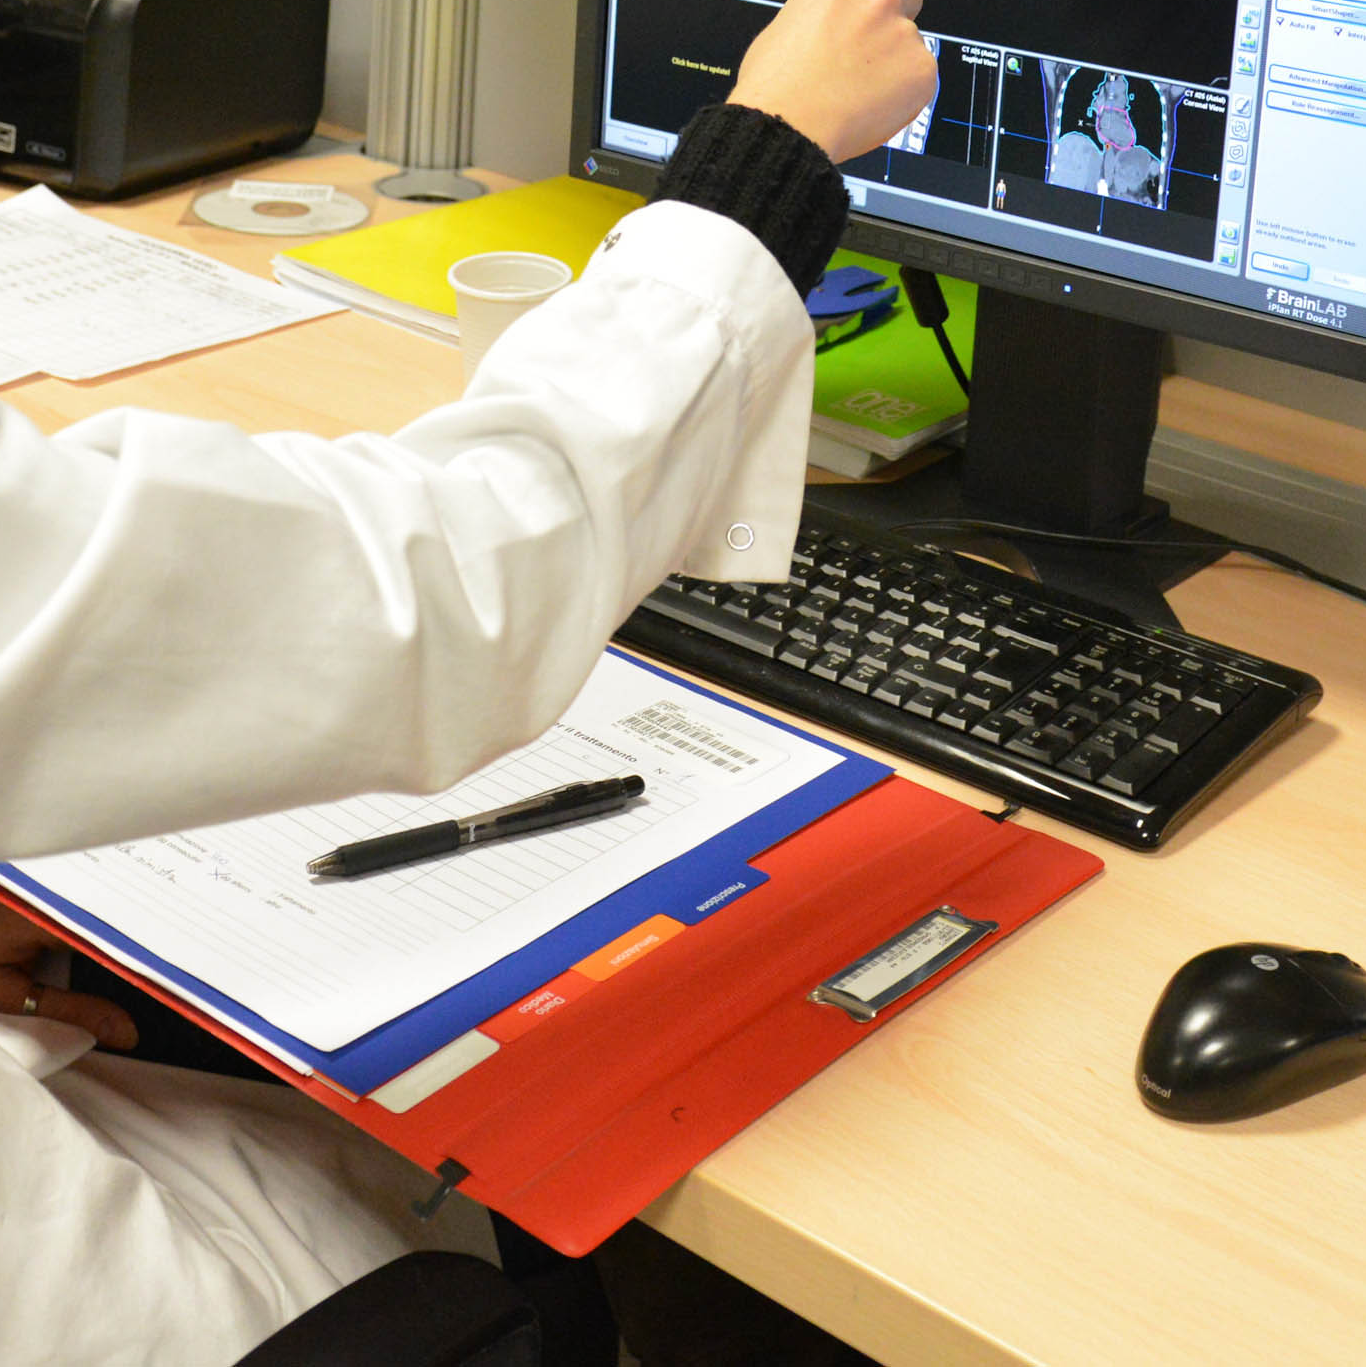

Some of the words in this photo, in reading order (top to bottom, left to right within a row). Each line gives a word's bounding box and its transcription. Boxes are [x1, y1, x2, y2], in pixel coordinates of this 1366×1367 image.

[671, 56, 686, 67] Click
[1268, 302, 1290, 317] iPlan
[1292, 308, 1304, 320] RT
[1306, 310, 1329, 326] Dose
[1329, 316, 1343, 329] 4.1
[1277, 288, 1348, 319] BrainLAB
[573, 729, 638, 764] trattamento
[696, 881, 747, 913] Prescrizione
[518, 990, 555, 1014] Medico
[535, 996, 566, 1016] Diario
